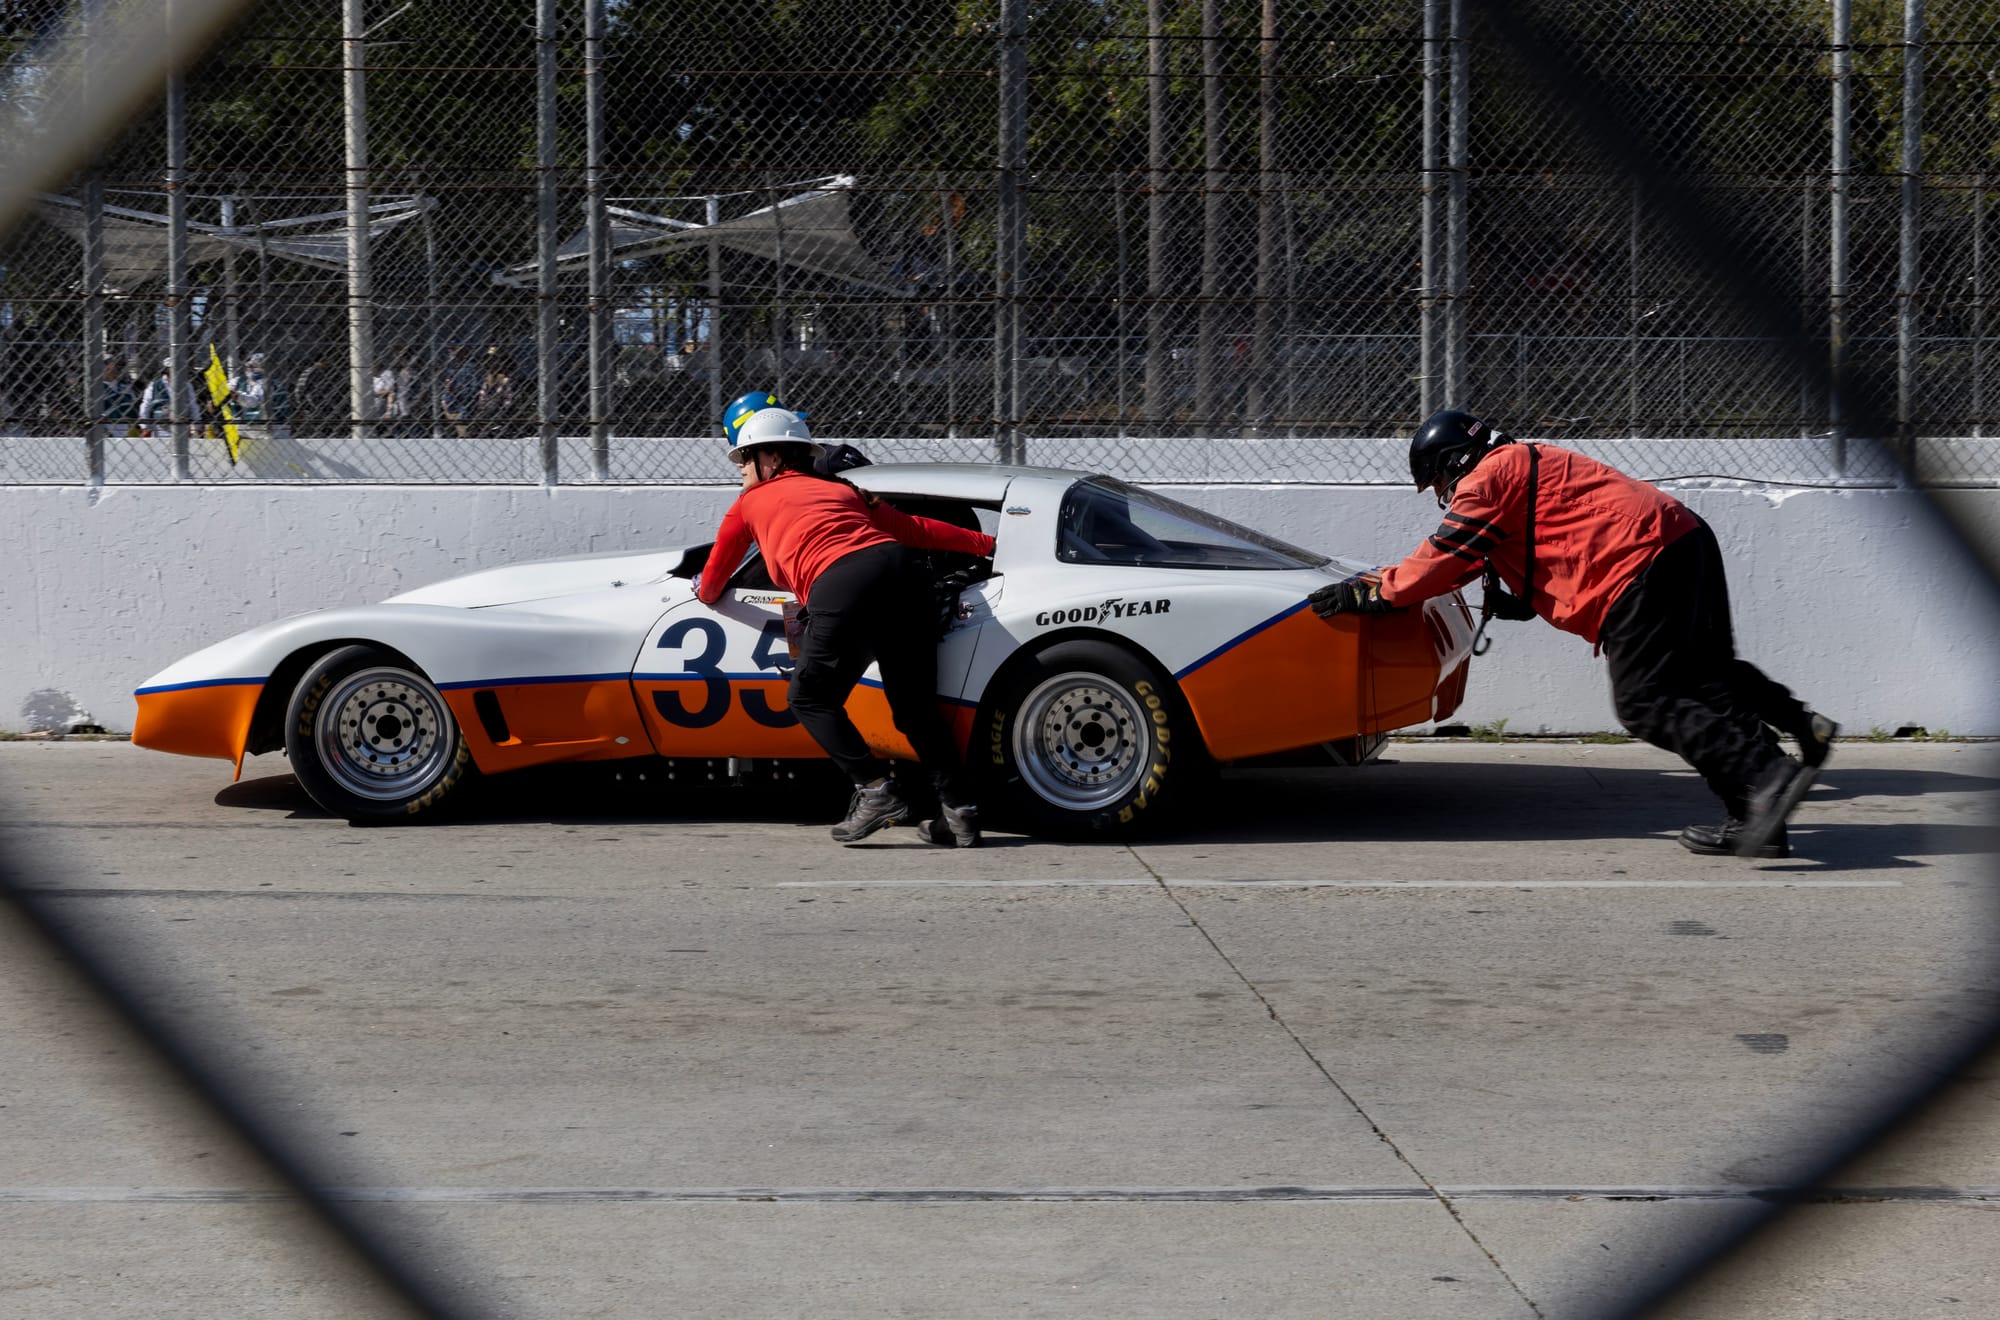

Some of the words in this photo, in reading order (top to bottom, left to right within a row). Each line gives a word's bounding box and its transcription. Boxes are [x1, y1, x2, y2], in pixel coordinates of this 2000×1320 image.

[1035, 598, 1171, 626] GOODYEAR
[652, 617, 801, 728] 35
[298, 673, 332, 736] EAGLE
[991, 708, 1006, 765] EAGLE
[1118, 680, 1171, 823] GOODYEAR
